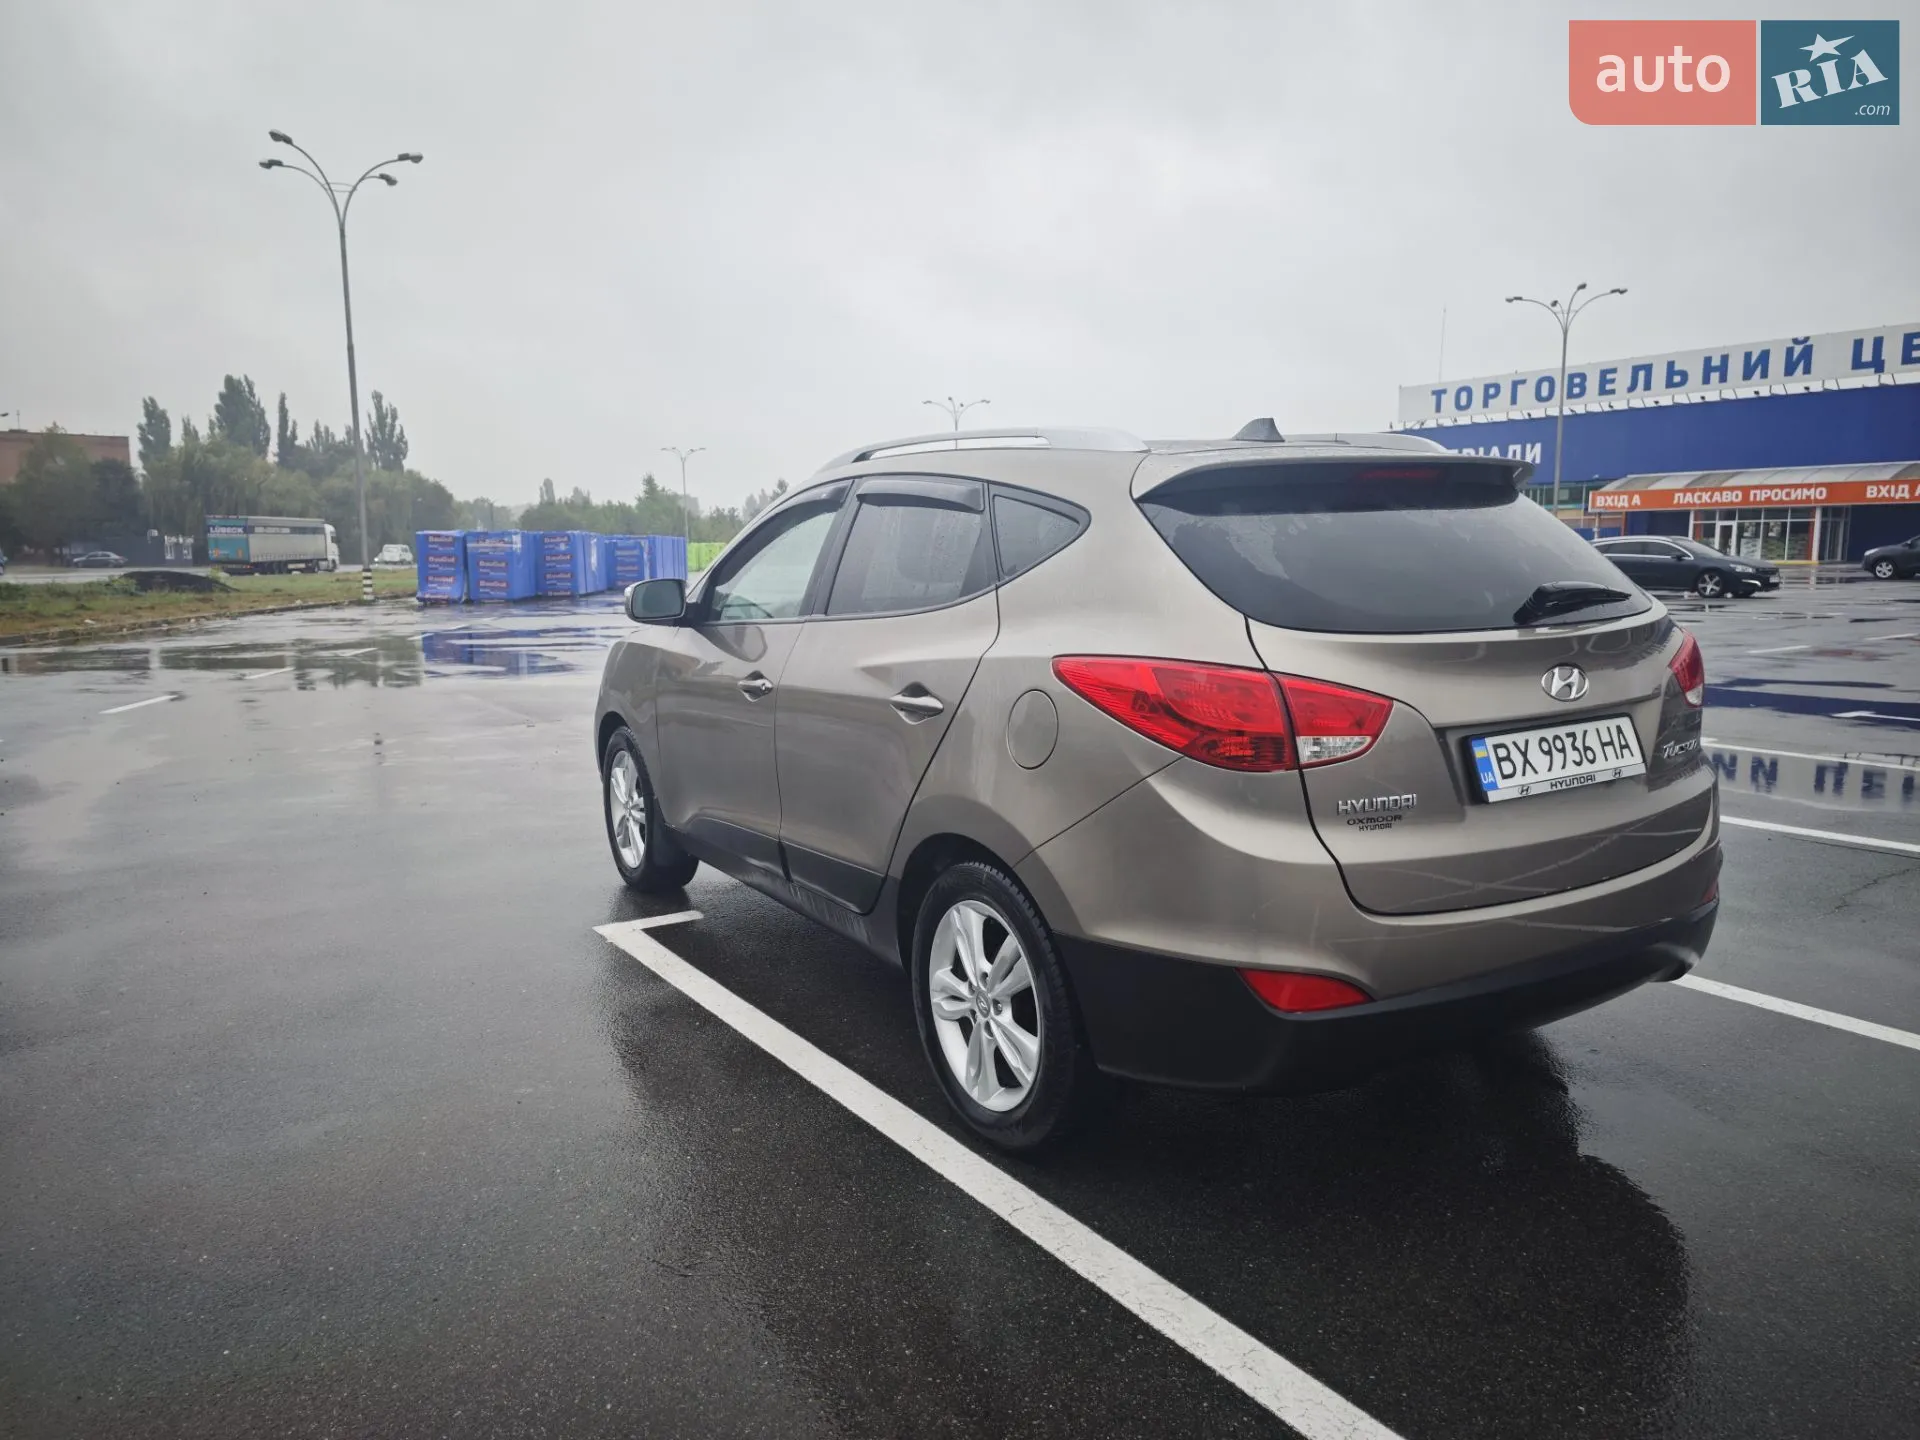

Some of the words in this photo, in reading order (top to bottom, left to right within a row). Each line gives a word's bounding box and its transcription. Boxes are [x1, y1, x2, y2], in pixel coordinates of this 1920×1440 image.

[1431, 336, 1813, 413] ТОРГОВЕЛЬНИЙ
[1673, 489, 1743, 504] ЛАСКАВО
[1749, 487, 1827, 502] ПРОСИМО
[1866, 484, 1910, 499] ВХІД
[1596, 494, 1629, 508] ВХІД
[1493, 738, 1539, 780] BX
[1538, 729, 1597, 773] 9936
[1596, 724, 1635, 762] HA
[1480, 772, 1496, 784] UA
[1550, 774, 1596, 790] HYUNDAI
[1337, 793, 1417, 815] HYUNDAI
[1358, 822, 1393, 832] HYUNDAI
